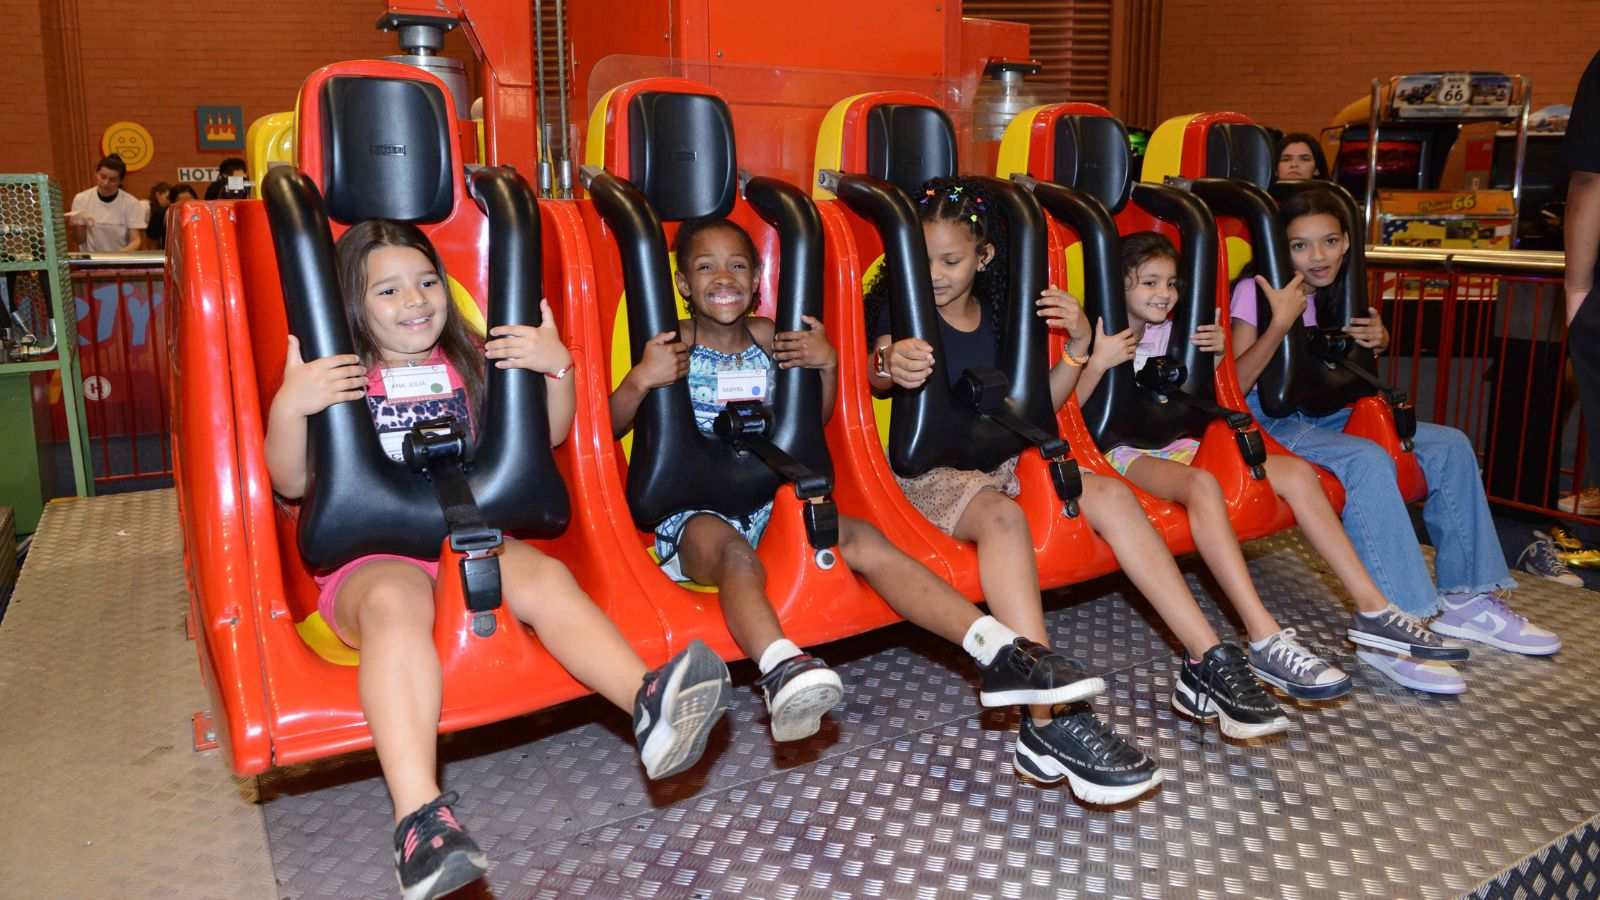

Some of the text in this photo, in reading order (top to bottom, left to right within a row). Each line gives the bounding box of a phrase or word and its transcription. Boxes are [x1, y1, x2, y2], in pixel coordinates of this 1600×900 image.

[1443, 90, 1464, 101] 66
[180, 168, 220, 181] HOT
[1452, 194, 1474, 210] 66
